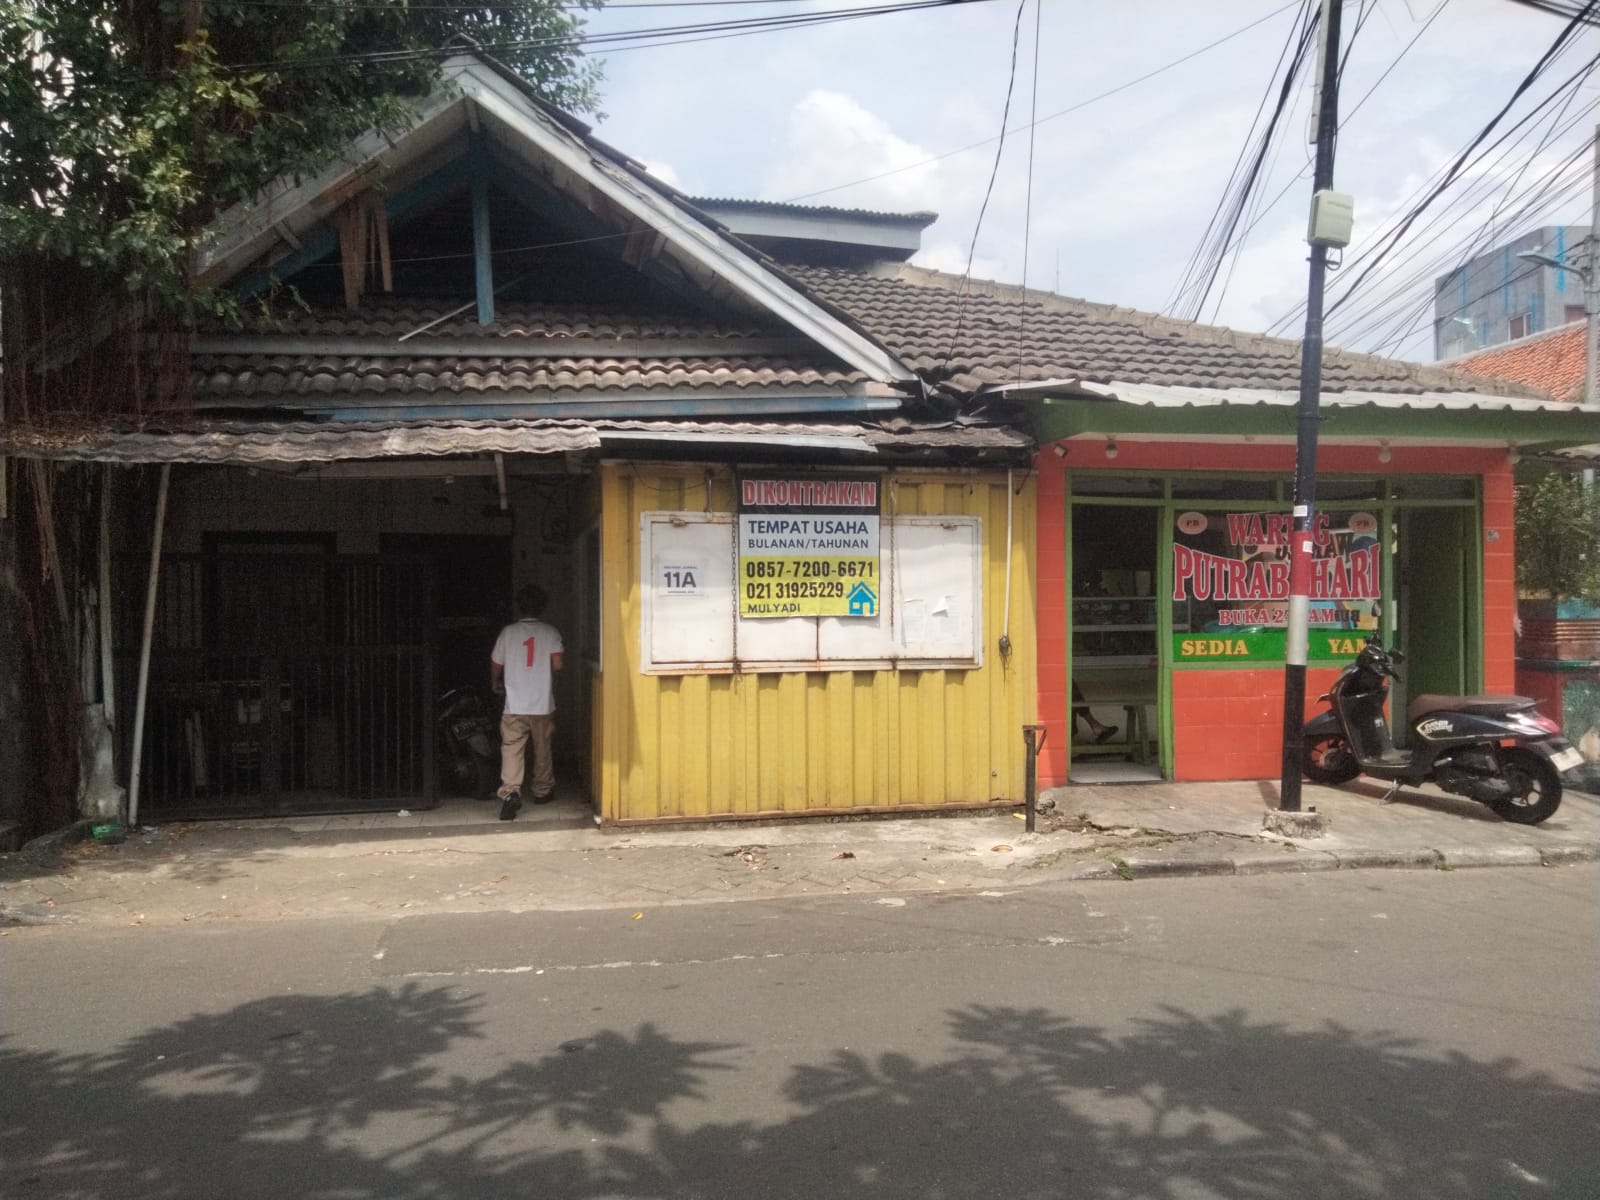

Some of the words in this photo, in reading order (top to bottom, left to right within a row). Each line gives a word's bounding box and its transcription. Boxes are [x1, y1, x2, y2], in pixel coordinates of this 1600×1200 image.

[742, 479, 877, 507] DIKONTRAKAN
[748, 520, 811, 535] TEMPAT
[814, 521, 869, 535] USAHA
[748, 538, 869, 549] BULANAN/TAHUNAN
[746, 561, 873, 578] 0857-7200-6671
[1173, 542, 1381, 601] PUTRABHARI
[664, 571, 697, 588] 11A
[746, 582, 771, 599] 021
[775, 581, 844, 599] 31925229
[747, 603, 801, 614] MULYADI
[1218, 609, 1272, 625] BUKA
[1307, 608, 1336, 624] AM
[523, 636, 535, 668] 1
[1181, 639, 1249, 656] SEDIA
